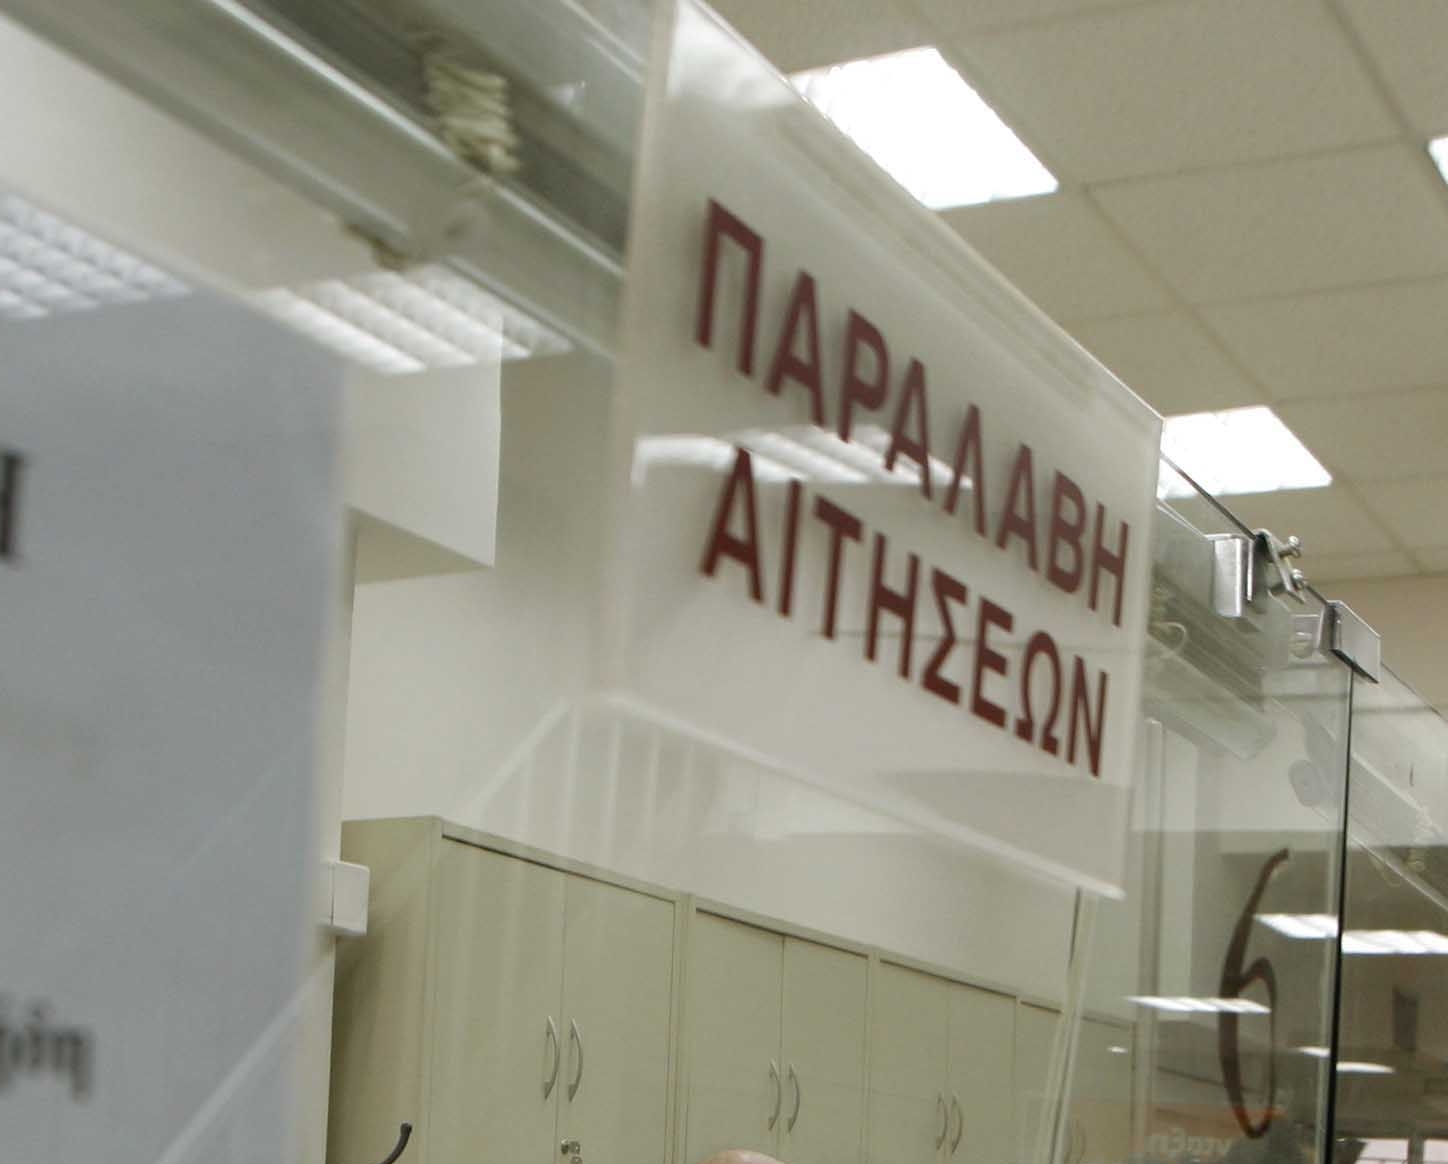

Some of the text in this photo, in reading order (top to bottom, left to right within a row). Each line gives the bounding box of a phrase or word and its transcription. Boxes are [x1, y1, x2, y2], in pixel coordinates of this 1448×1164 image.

[695, 195, 1130, 629] ΠΑΡΑΛΑΒΗ
[698, 445, 1109, 779] ΑΙΤΗΣΕΩΝ
[1218, 846, 1291, 1140] 6
